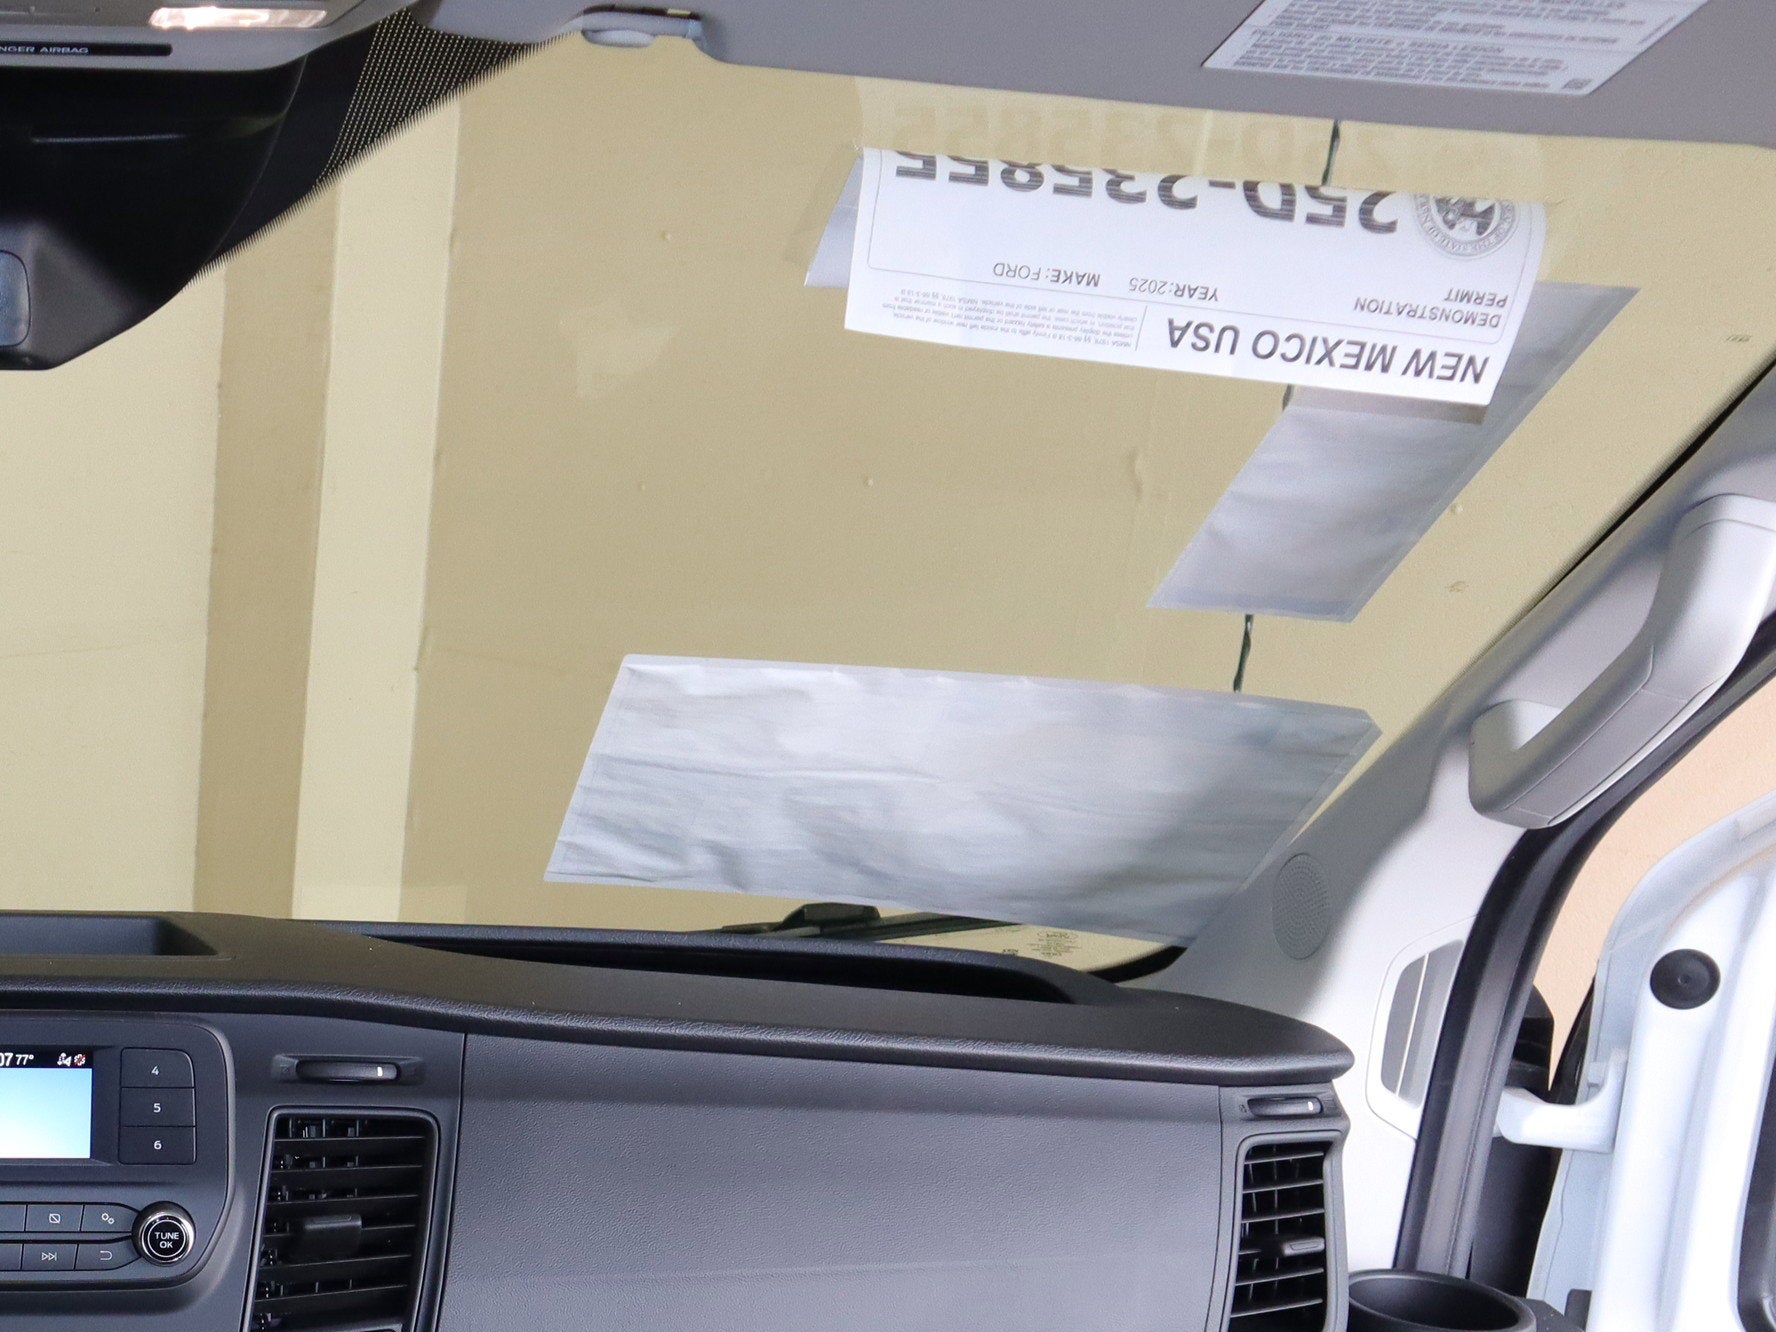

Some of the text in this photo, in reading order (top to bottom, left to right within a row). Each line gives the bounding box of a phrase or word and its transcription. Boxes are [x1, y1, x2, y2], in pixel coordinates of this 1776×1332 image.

[39, 46, 89, 54] AIRBAG
[993, 262, 1042, 281] FORD
[1045, 267, 1101, 288] MAKE:
[1444, 287, 1509, 308] PERMIT
[1354, 297, 1502, 328] DEMONSTRATION
[1167, 317, 1491, 385] NEW MEXICO USA
[151, 1065, 160, 1076] 4
[153, 1103, 161, 1113] 5
[153, 1140, 162, 1150] 6
[154, 1231, 180, 1240] TUNE
[159, 1241, 173, 1249] OK
